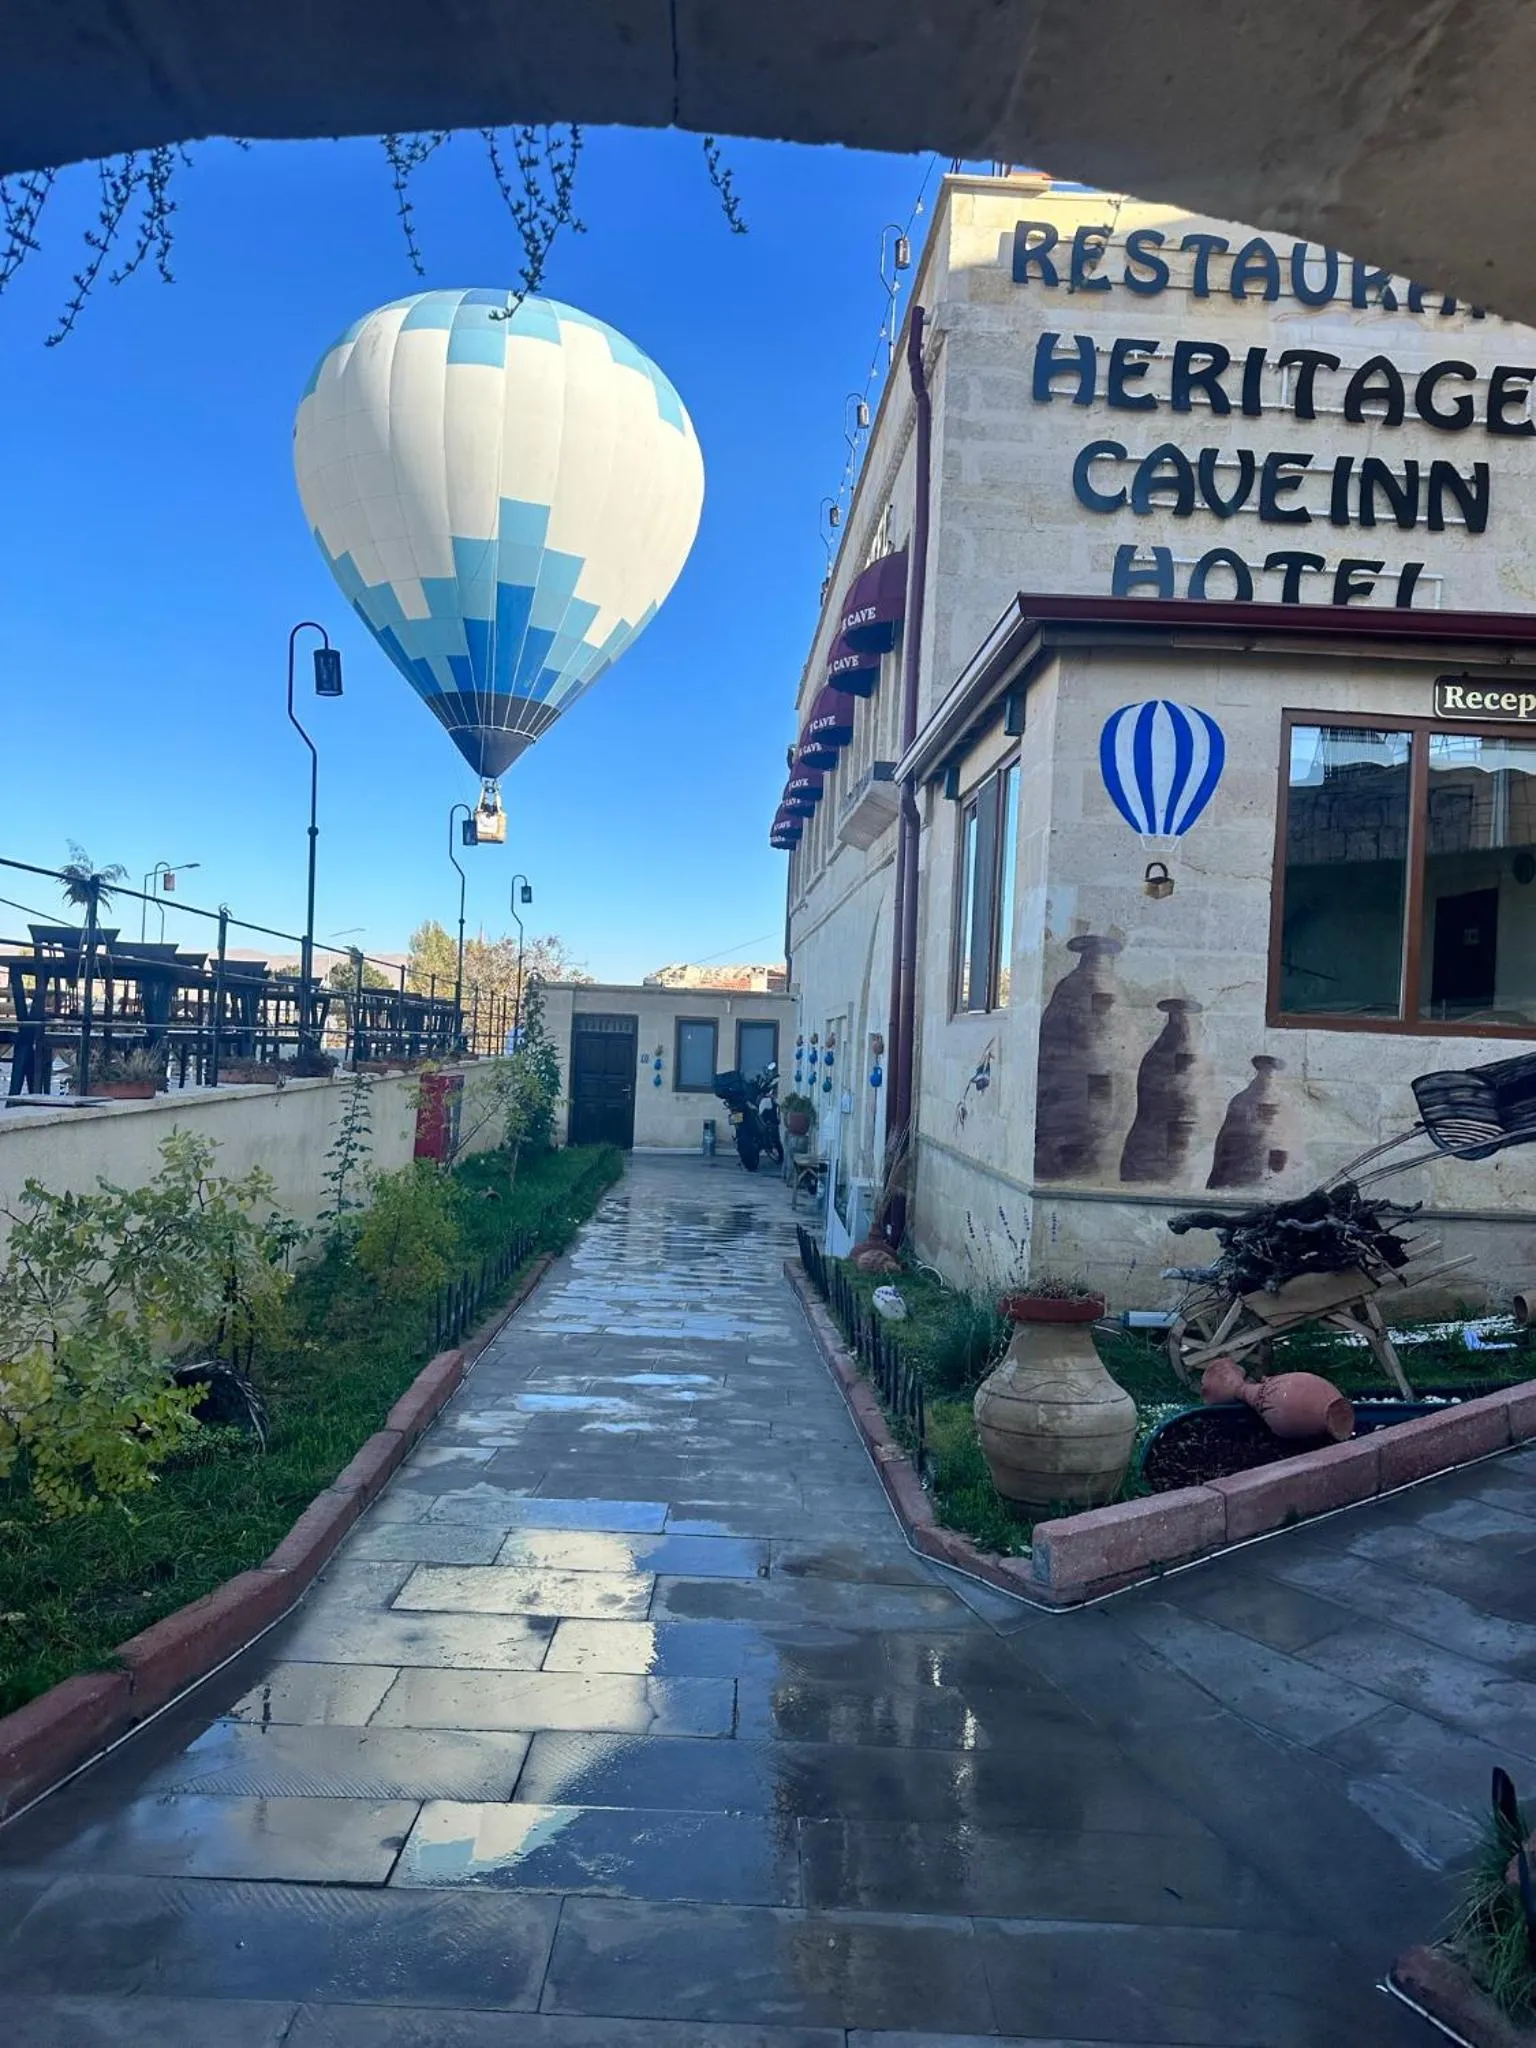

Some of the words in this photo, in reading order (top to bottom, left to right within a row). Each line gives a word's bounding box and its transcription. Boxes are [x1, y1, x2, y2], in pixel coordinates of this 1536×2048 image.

[1012, 220, 1486, 319] RESTAUR
[1032, 332, 1536, 436] HERITAGE
[1073, 440, 1314, 524] CAVE
[1331, 456, 1489, 533] INN
[847, 606, 876, 627] CAVE
[833, 654, 859, 671] CAVE
[1444, 685, 1536, 718] Recep
[813, 715, 835, 730] CAVE
